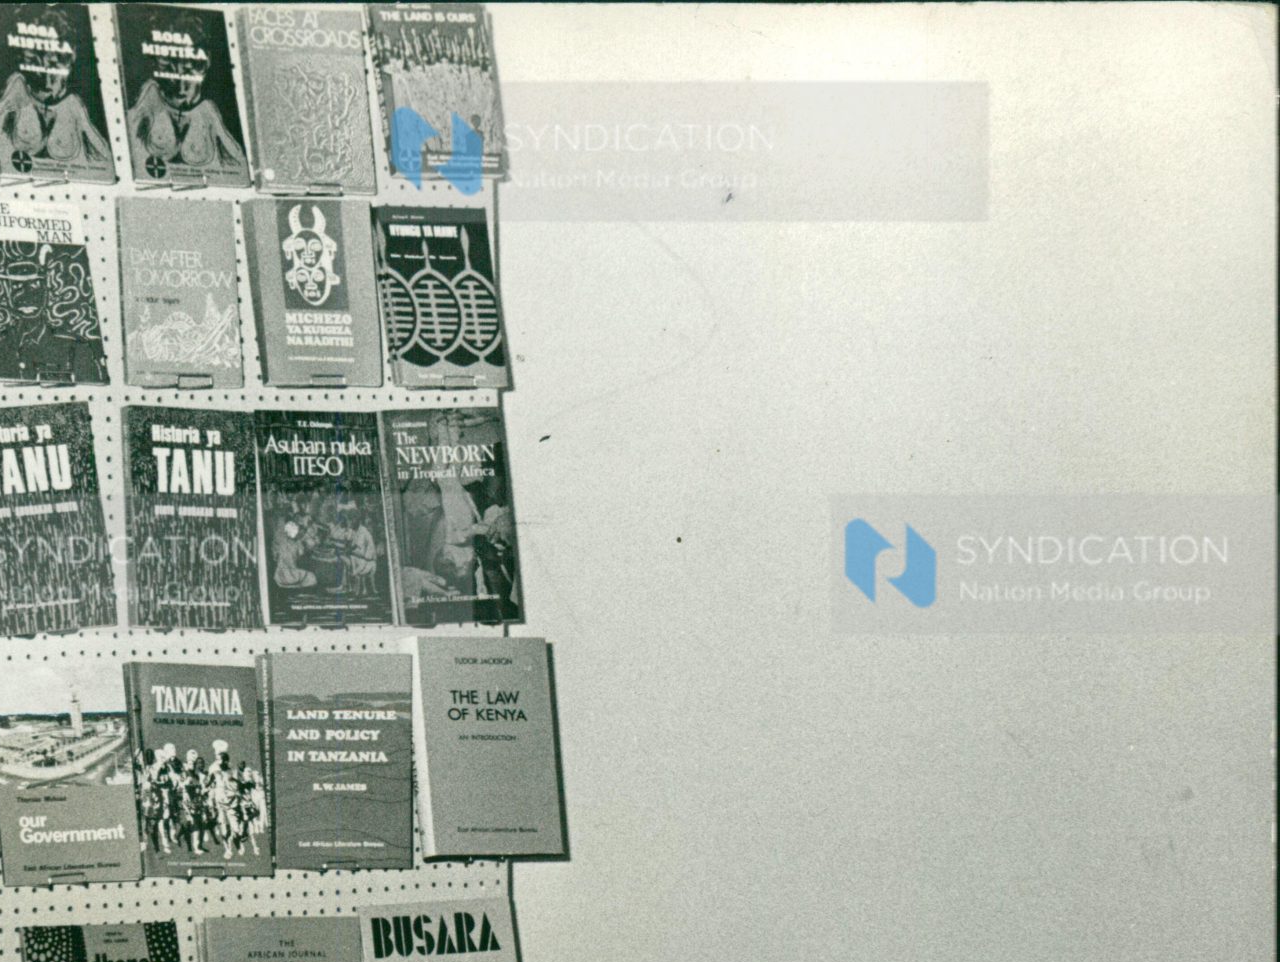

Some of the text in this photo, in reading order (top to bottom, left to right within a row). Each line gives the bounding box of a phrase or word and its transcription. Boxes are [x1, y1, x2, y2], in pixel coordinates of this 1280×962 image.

[248, 8, 295, 28] FACES
[380, 11, 476, 23] THE LAND IS OURS
[17, 22, 59, 39] ROSA
[151, 29, 193, 46] ROSA
[250, 26, 361, 48] CROSSROADS
[7, 34, 75, 54] MISTIKA
[141, 42, 208, 62] MISTIKA
[36, 230, 73, 243] MAN
[130, 248, 202, 268] DAY AFTER
[130, 268, 233, 289] TOMORROW
[285, 312, 352, 325] MICHEZO
[35, 424, 53, 443] ya
[151, 424, 221, 448] Historia ya
[392, 431, 418, 445] The
[265, 434, 372, 455] Asuban nuka
[396, 444, 496, 466] NEWBORN
[152, 447, 235, 496] TANU
[293, 456, 344, 477] ITESO
[398, 464, 495, 482] in Tropical Africa
[455, 657, 479, 665] TUDOR
[151, 685, 244, 715] TANZANIA
[450, 690, 520, 705] THE LAW
[287, 709, 397, 721] LAND TENURE
[447, 707, 528, 722] OF KENYA
[286, 729, 381, 741] AND POLICY
[287, 751, 388, 763] IN TANZANIA
[19, 815, 47, 828] our
[20, 824, 125, 844] Government
[371, 911, 501, 959] BUSARA
[248, 950, 327, 959] AFRICAN JOURNAL
